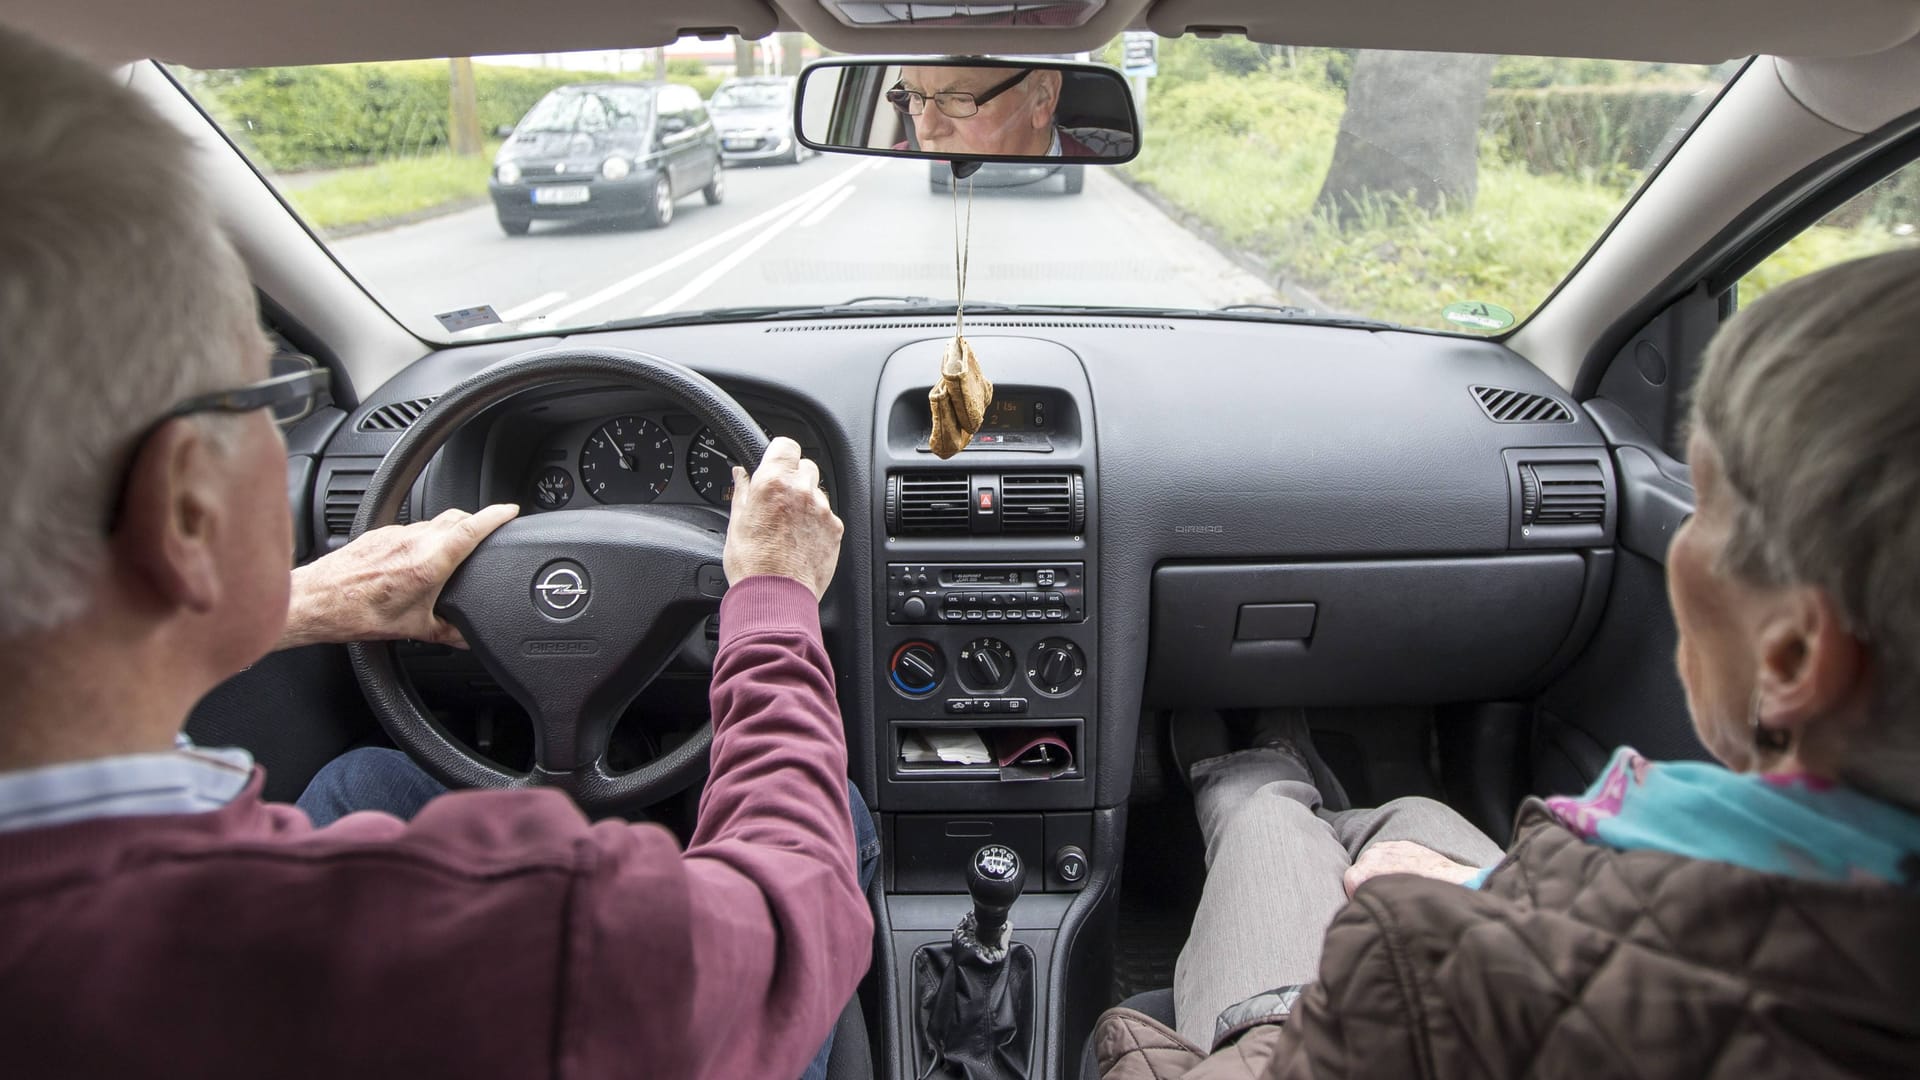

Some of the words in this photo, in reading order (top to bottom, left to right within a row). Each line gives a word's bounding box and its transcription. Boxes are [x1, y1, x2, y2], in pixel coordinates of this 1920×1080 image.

[655, 441, 661, 449] 5
[592, 462, 596, 470] 1
[660, 462, 666, 470] 6
[1175, 525, 1223, 533] AIRBAG
[529, 641, 590, 653] AIRBAG
[996, 641, 1001, 649] 3
[1005, 650, 1010, 658] 4
